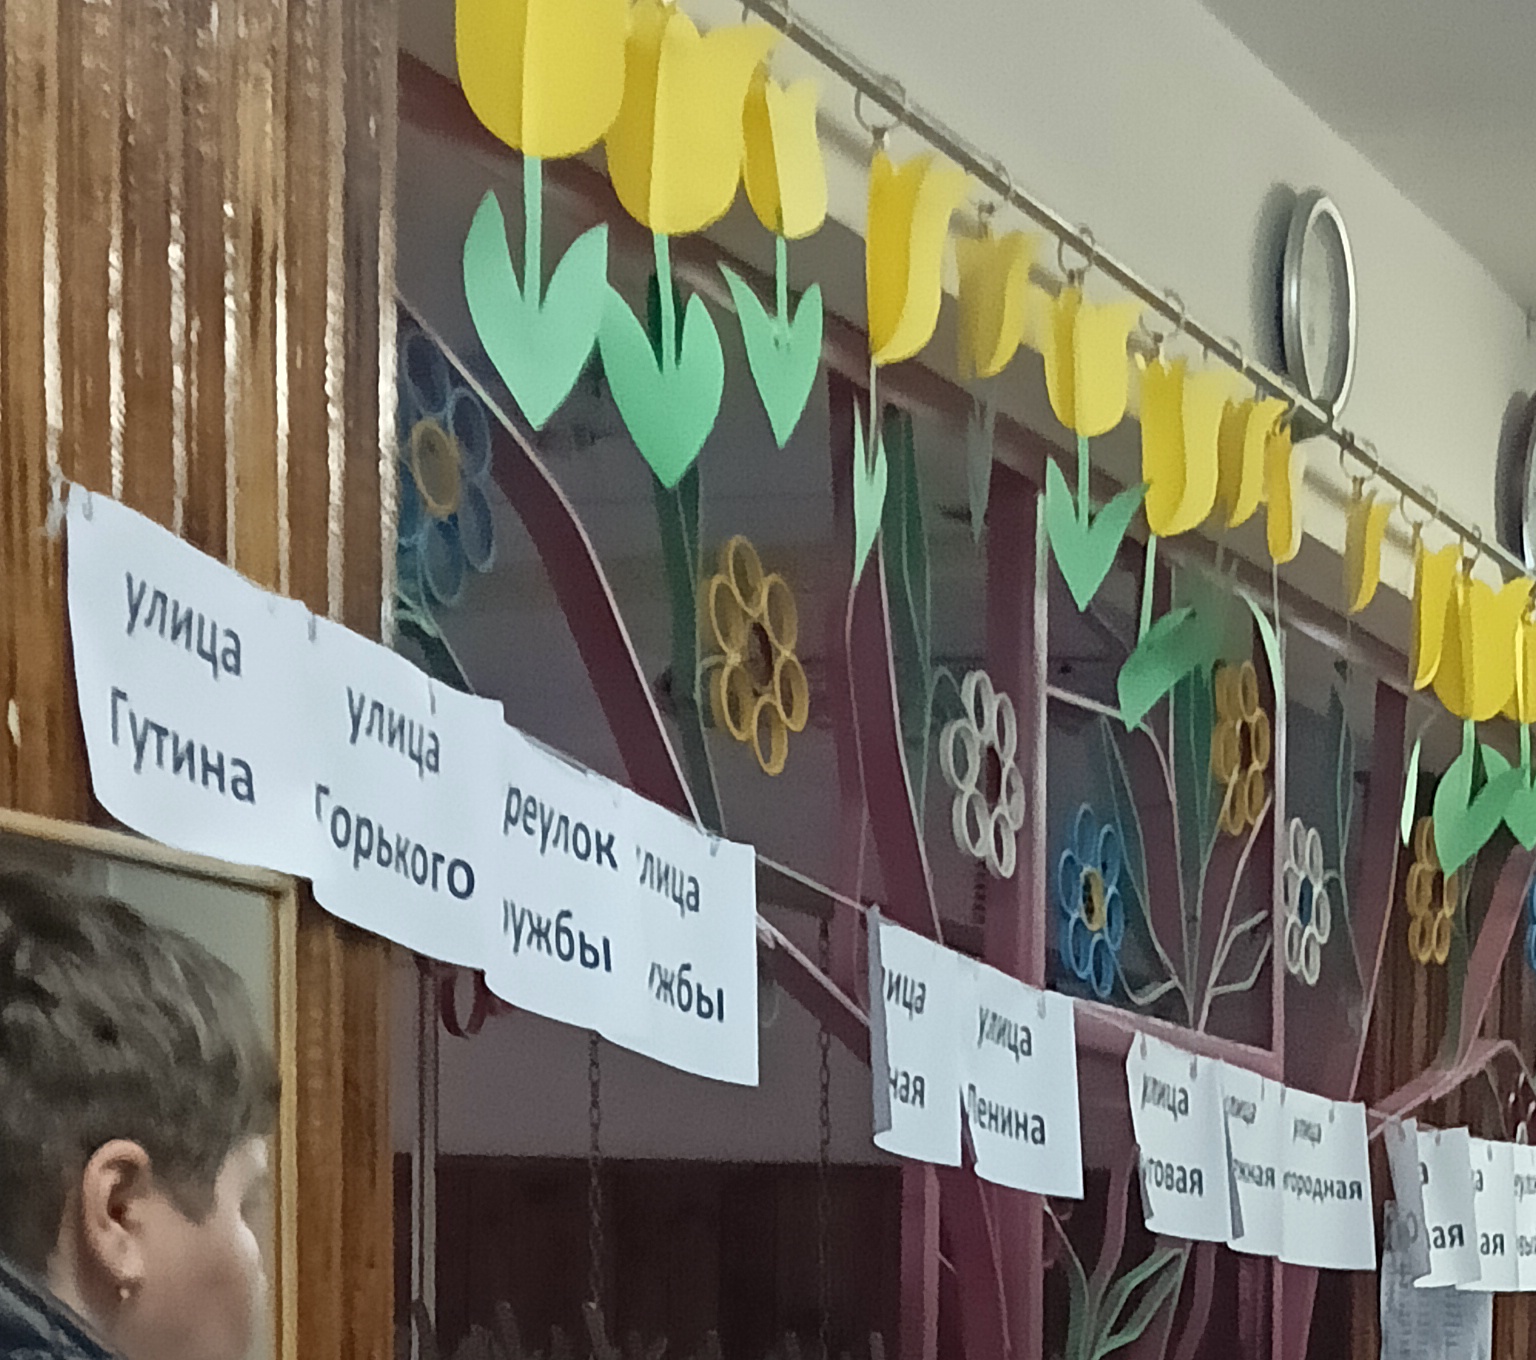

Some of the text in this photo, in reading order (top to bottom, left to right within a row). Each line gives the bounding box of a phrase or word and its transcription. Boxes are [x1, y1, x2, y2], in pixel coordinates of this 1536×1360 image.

[125, 571, 242, 681] улица
[110, 685, 256, 805] Гутина
[346, 685, 440, 781] улица
[503, 785, 618, 871] реулок
[635, 844, 700, 918] лица
[967, 1082, 1046, 1145] Ленина
